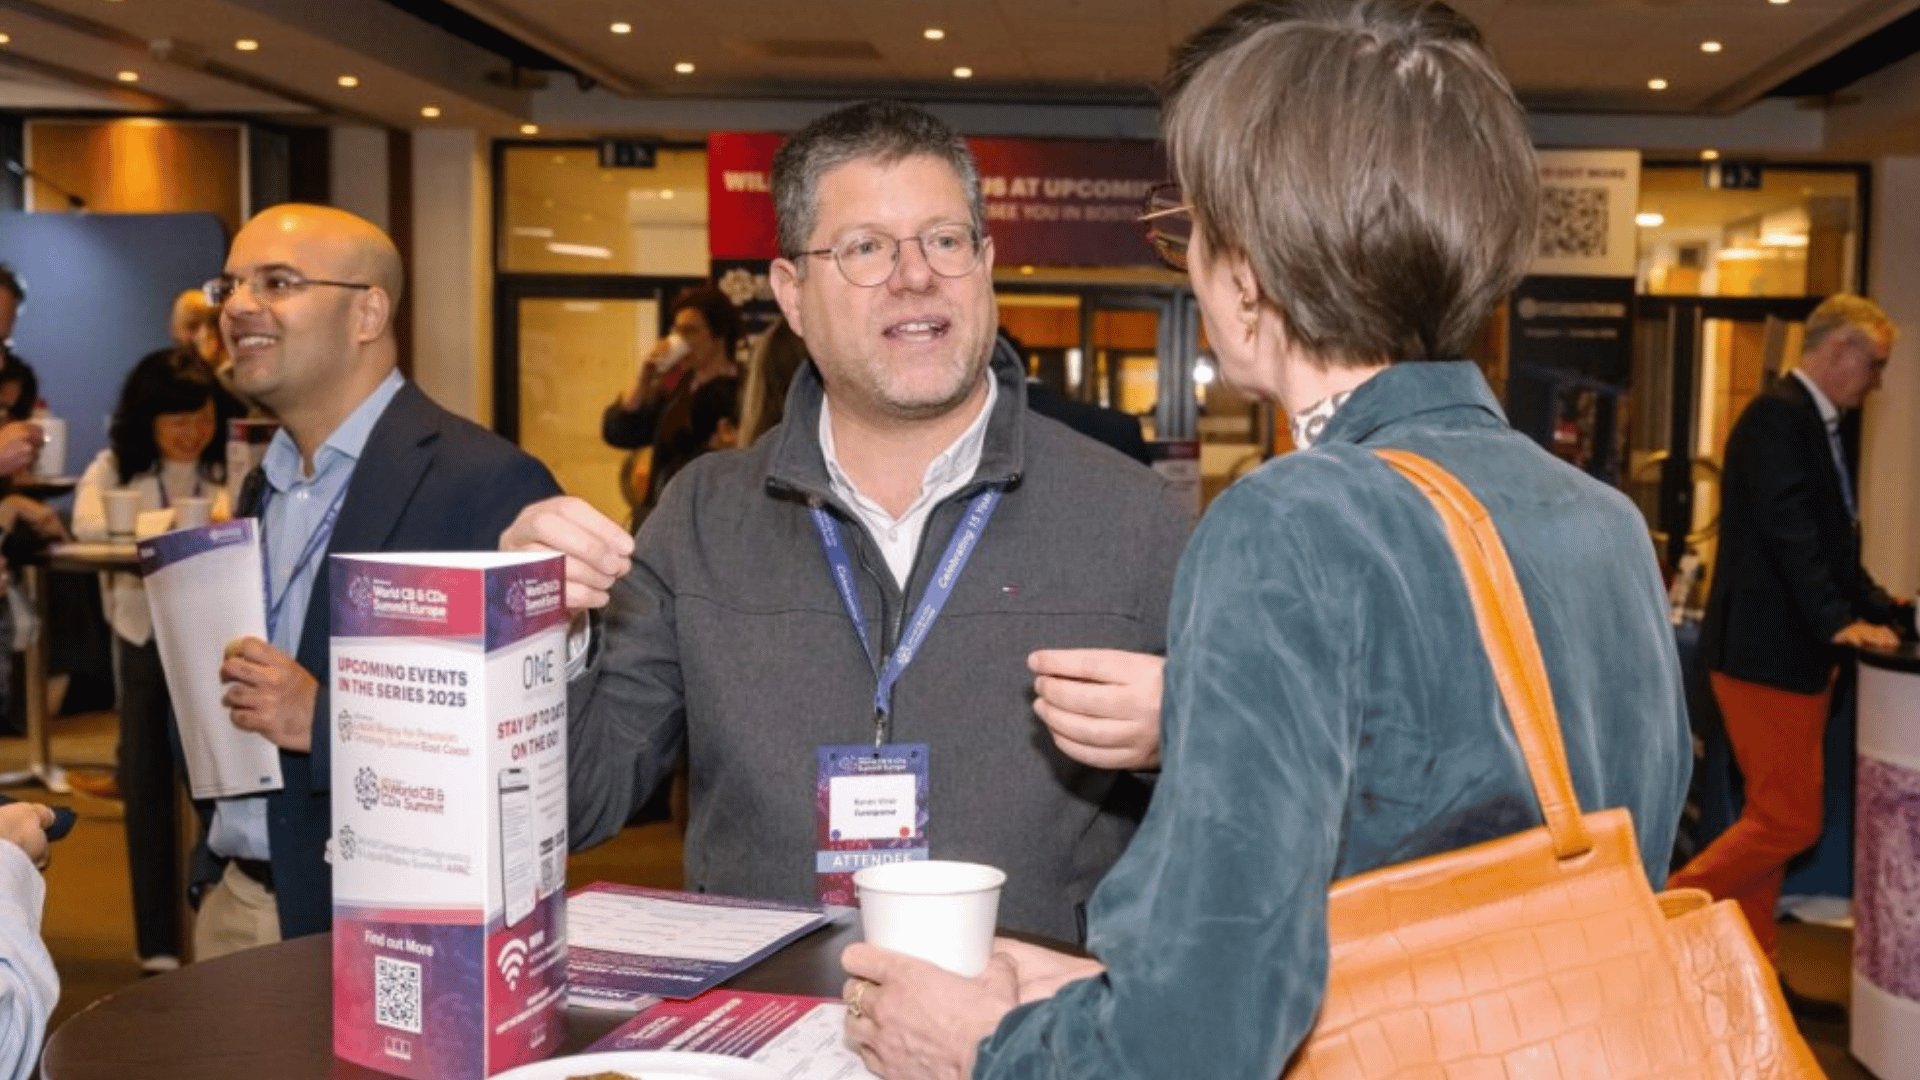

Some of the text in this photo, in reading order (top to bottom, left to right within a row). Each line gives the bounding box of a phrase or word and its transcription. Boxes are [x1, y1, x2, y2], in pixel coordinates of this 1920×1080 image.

[1010, 177, 1039, 198] AT
[337, 656, 468, 687] UPCOMING EVENTS
[337, 676, 468, 708] IN THE SERIES 2025
[497, 716, 524, 740] STAY
[525, 712, 538, 732] UP
[511, 742, 528, 761] ON
[529, 734, 546, 754] THE
[364, 929, 434, 958] Find out More
